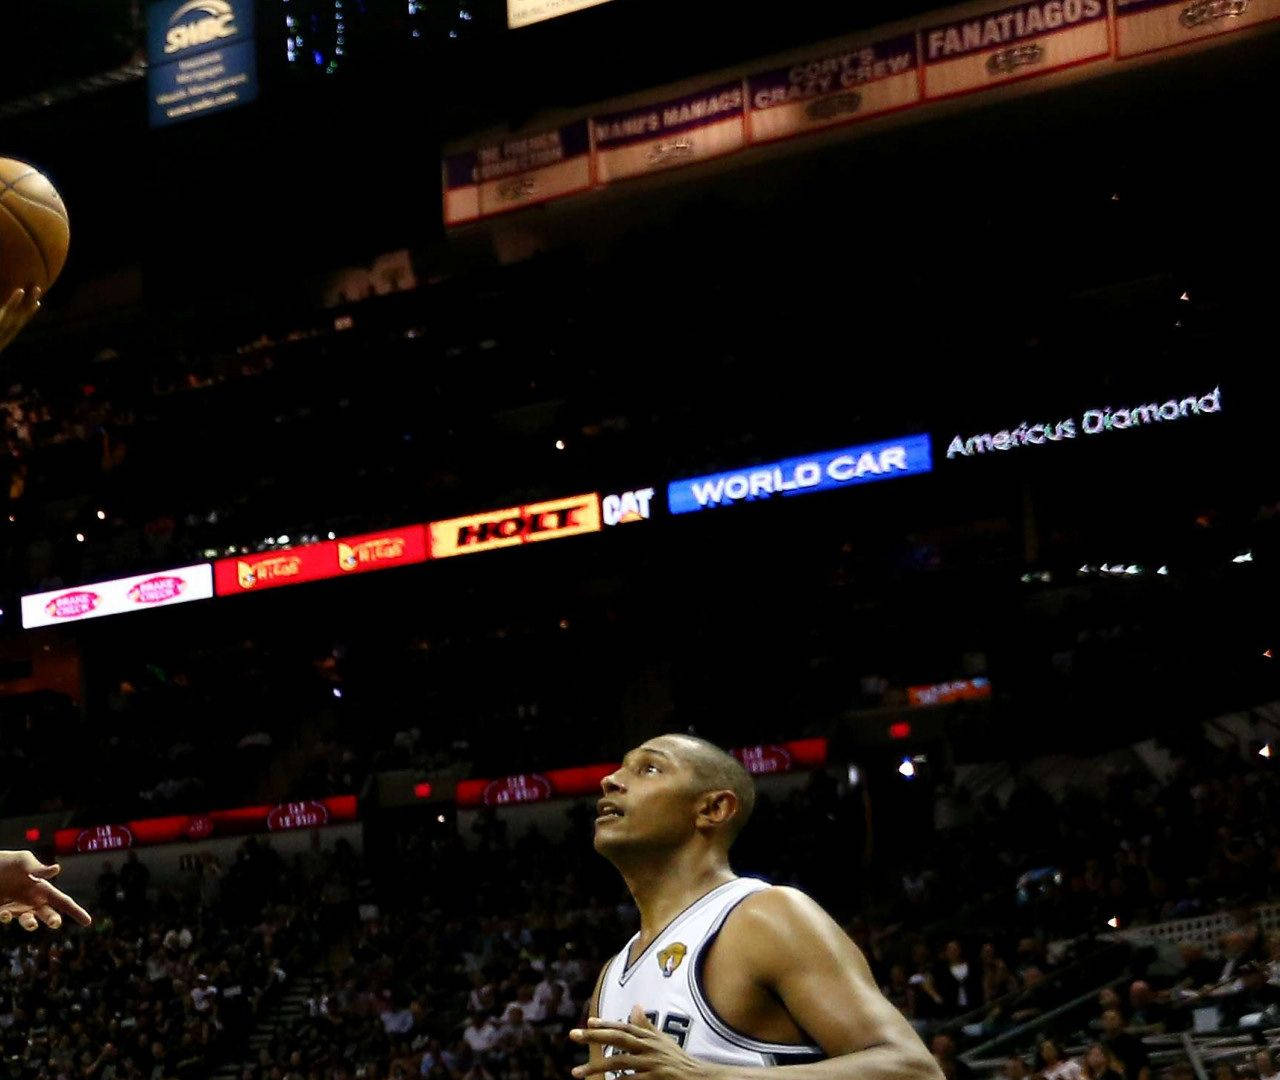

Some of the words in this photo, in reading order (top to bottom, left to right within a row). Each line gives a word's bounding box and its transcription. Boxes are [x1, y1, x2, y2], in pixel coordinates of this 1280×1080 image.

[946, 417, 1077, 459] Americus
[1082, 385, 1221, 434] Diamond
[692, 461, 821, 506] WORLD
[826, 446, 907, 481] CAR
[457, 504, 587, 547] HOLT
[603, 487, 654, 526] CAT
